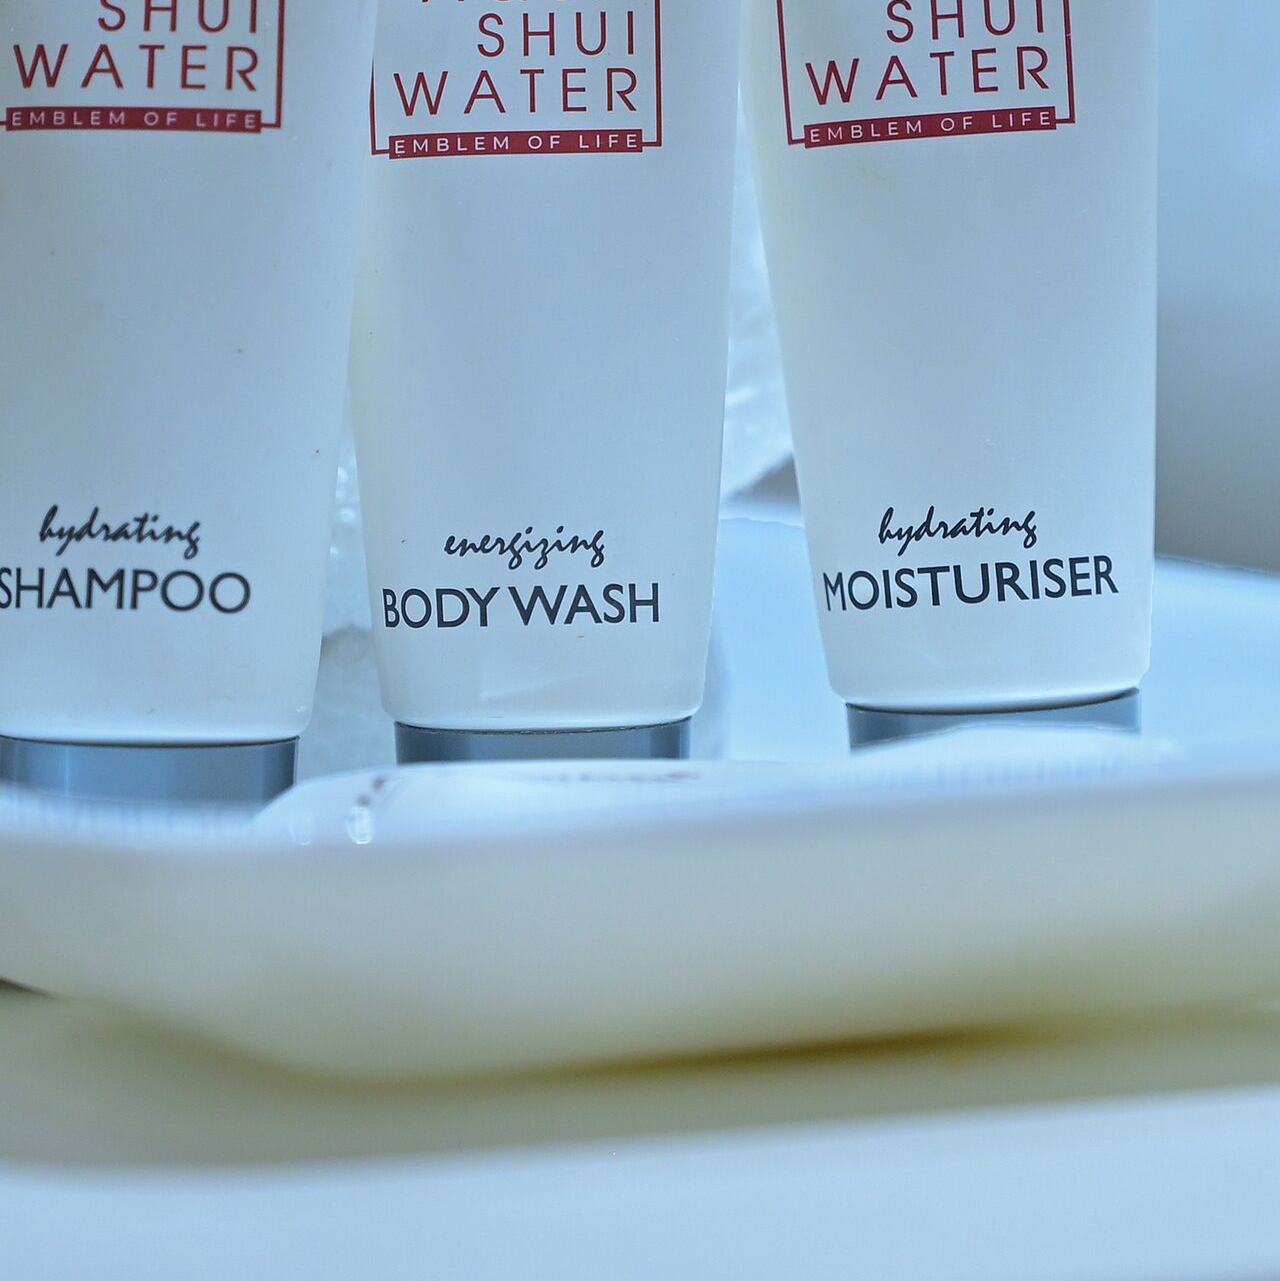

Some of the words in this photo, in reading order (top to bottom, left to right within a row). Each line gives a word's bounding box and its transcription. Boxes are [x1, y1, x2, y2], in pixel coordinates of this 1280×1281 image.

[477, 11, 634, 57] SHUI
[13, 44, 258, 91] WATER
[805, 46, 1049, 105] WATER
[393, 68, 637, 116] WATER
[12, 111, 125, 126] EMBLEM
[144, 112, 177, 126] OF
[196, 113, 256, 129] LIFE
[810, 120, 922, 143] EMBLEM
[940, 116, 974, 132] OF
[992, 111, 1051, 129] LIFE
[394, 136, 510, 154] EMBLEM
[528, 136, 561, 150] OF
[579, 134, 638, 149] LIFE
[39, 504, 201, 559] hydrating
[443, 525, 605, 570] energizing
[878, 505, 1038, 557] hydrating
[383, 586, 500, 628] BODY
[508, 582, 660, 627] WASH
[823, 555, 1119, 611] MOISTURISER
